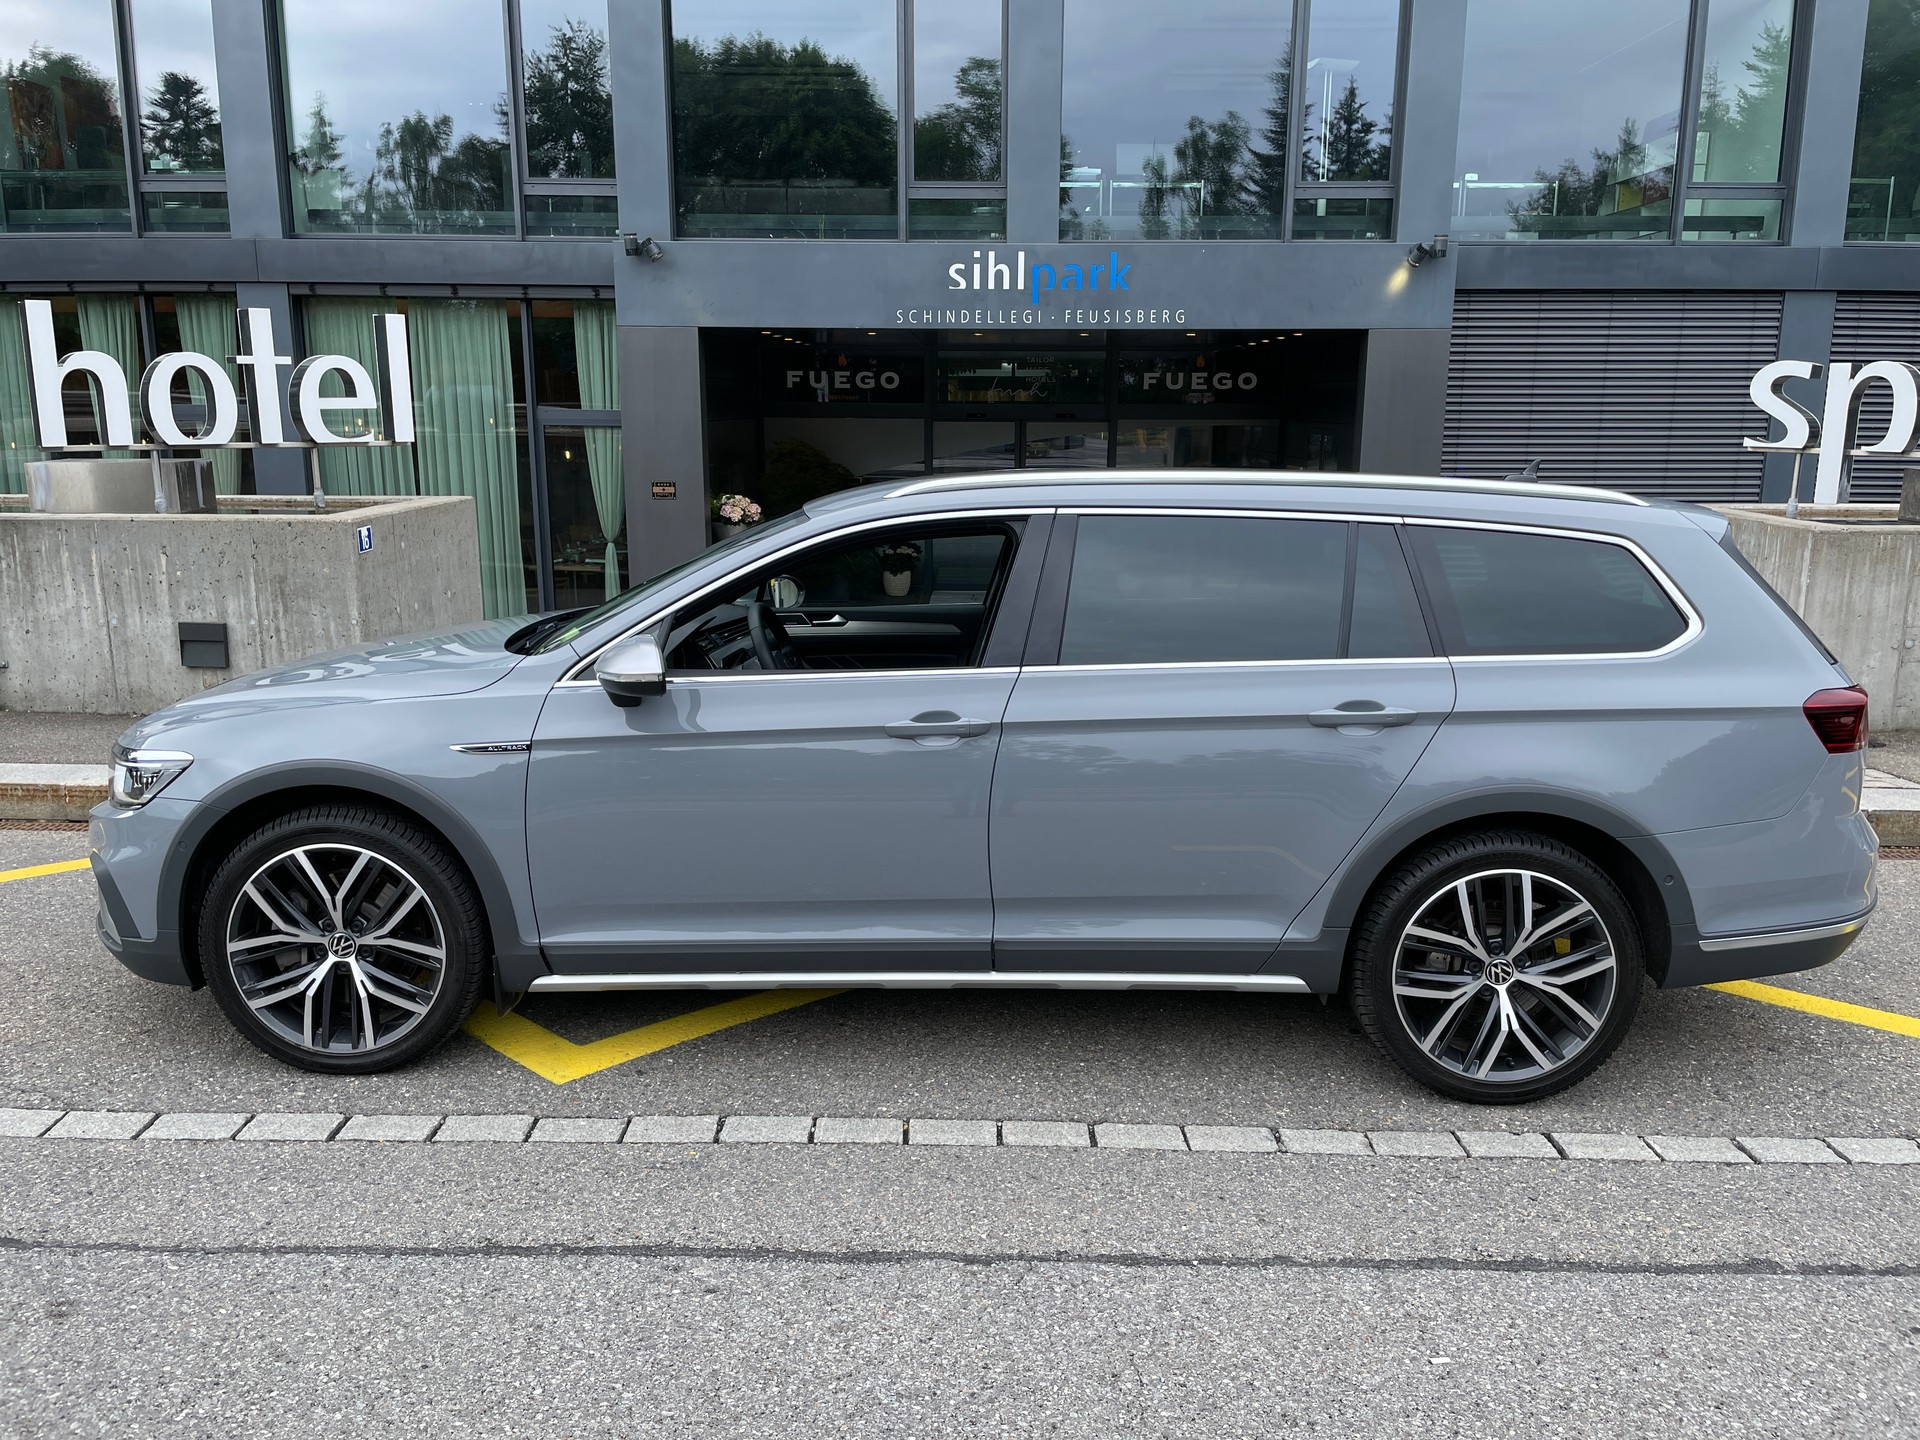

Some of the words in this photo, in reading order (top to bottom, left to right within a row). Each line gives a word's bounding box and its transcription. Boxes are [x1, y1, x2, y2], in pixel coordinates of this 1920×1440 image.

[948, 250, 1131, 304] sihlpark
[896, 309, 1043, 324] SCHINDELLEGI
[1065, 309, 1186, 323] FEUSISBERG
[18, 299, 415, 447] hotel
[786, 370, 900, 389] FUEGO
[1143, 372, 1258, 390] FUEGO
